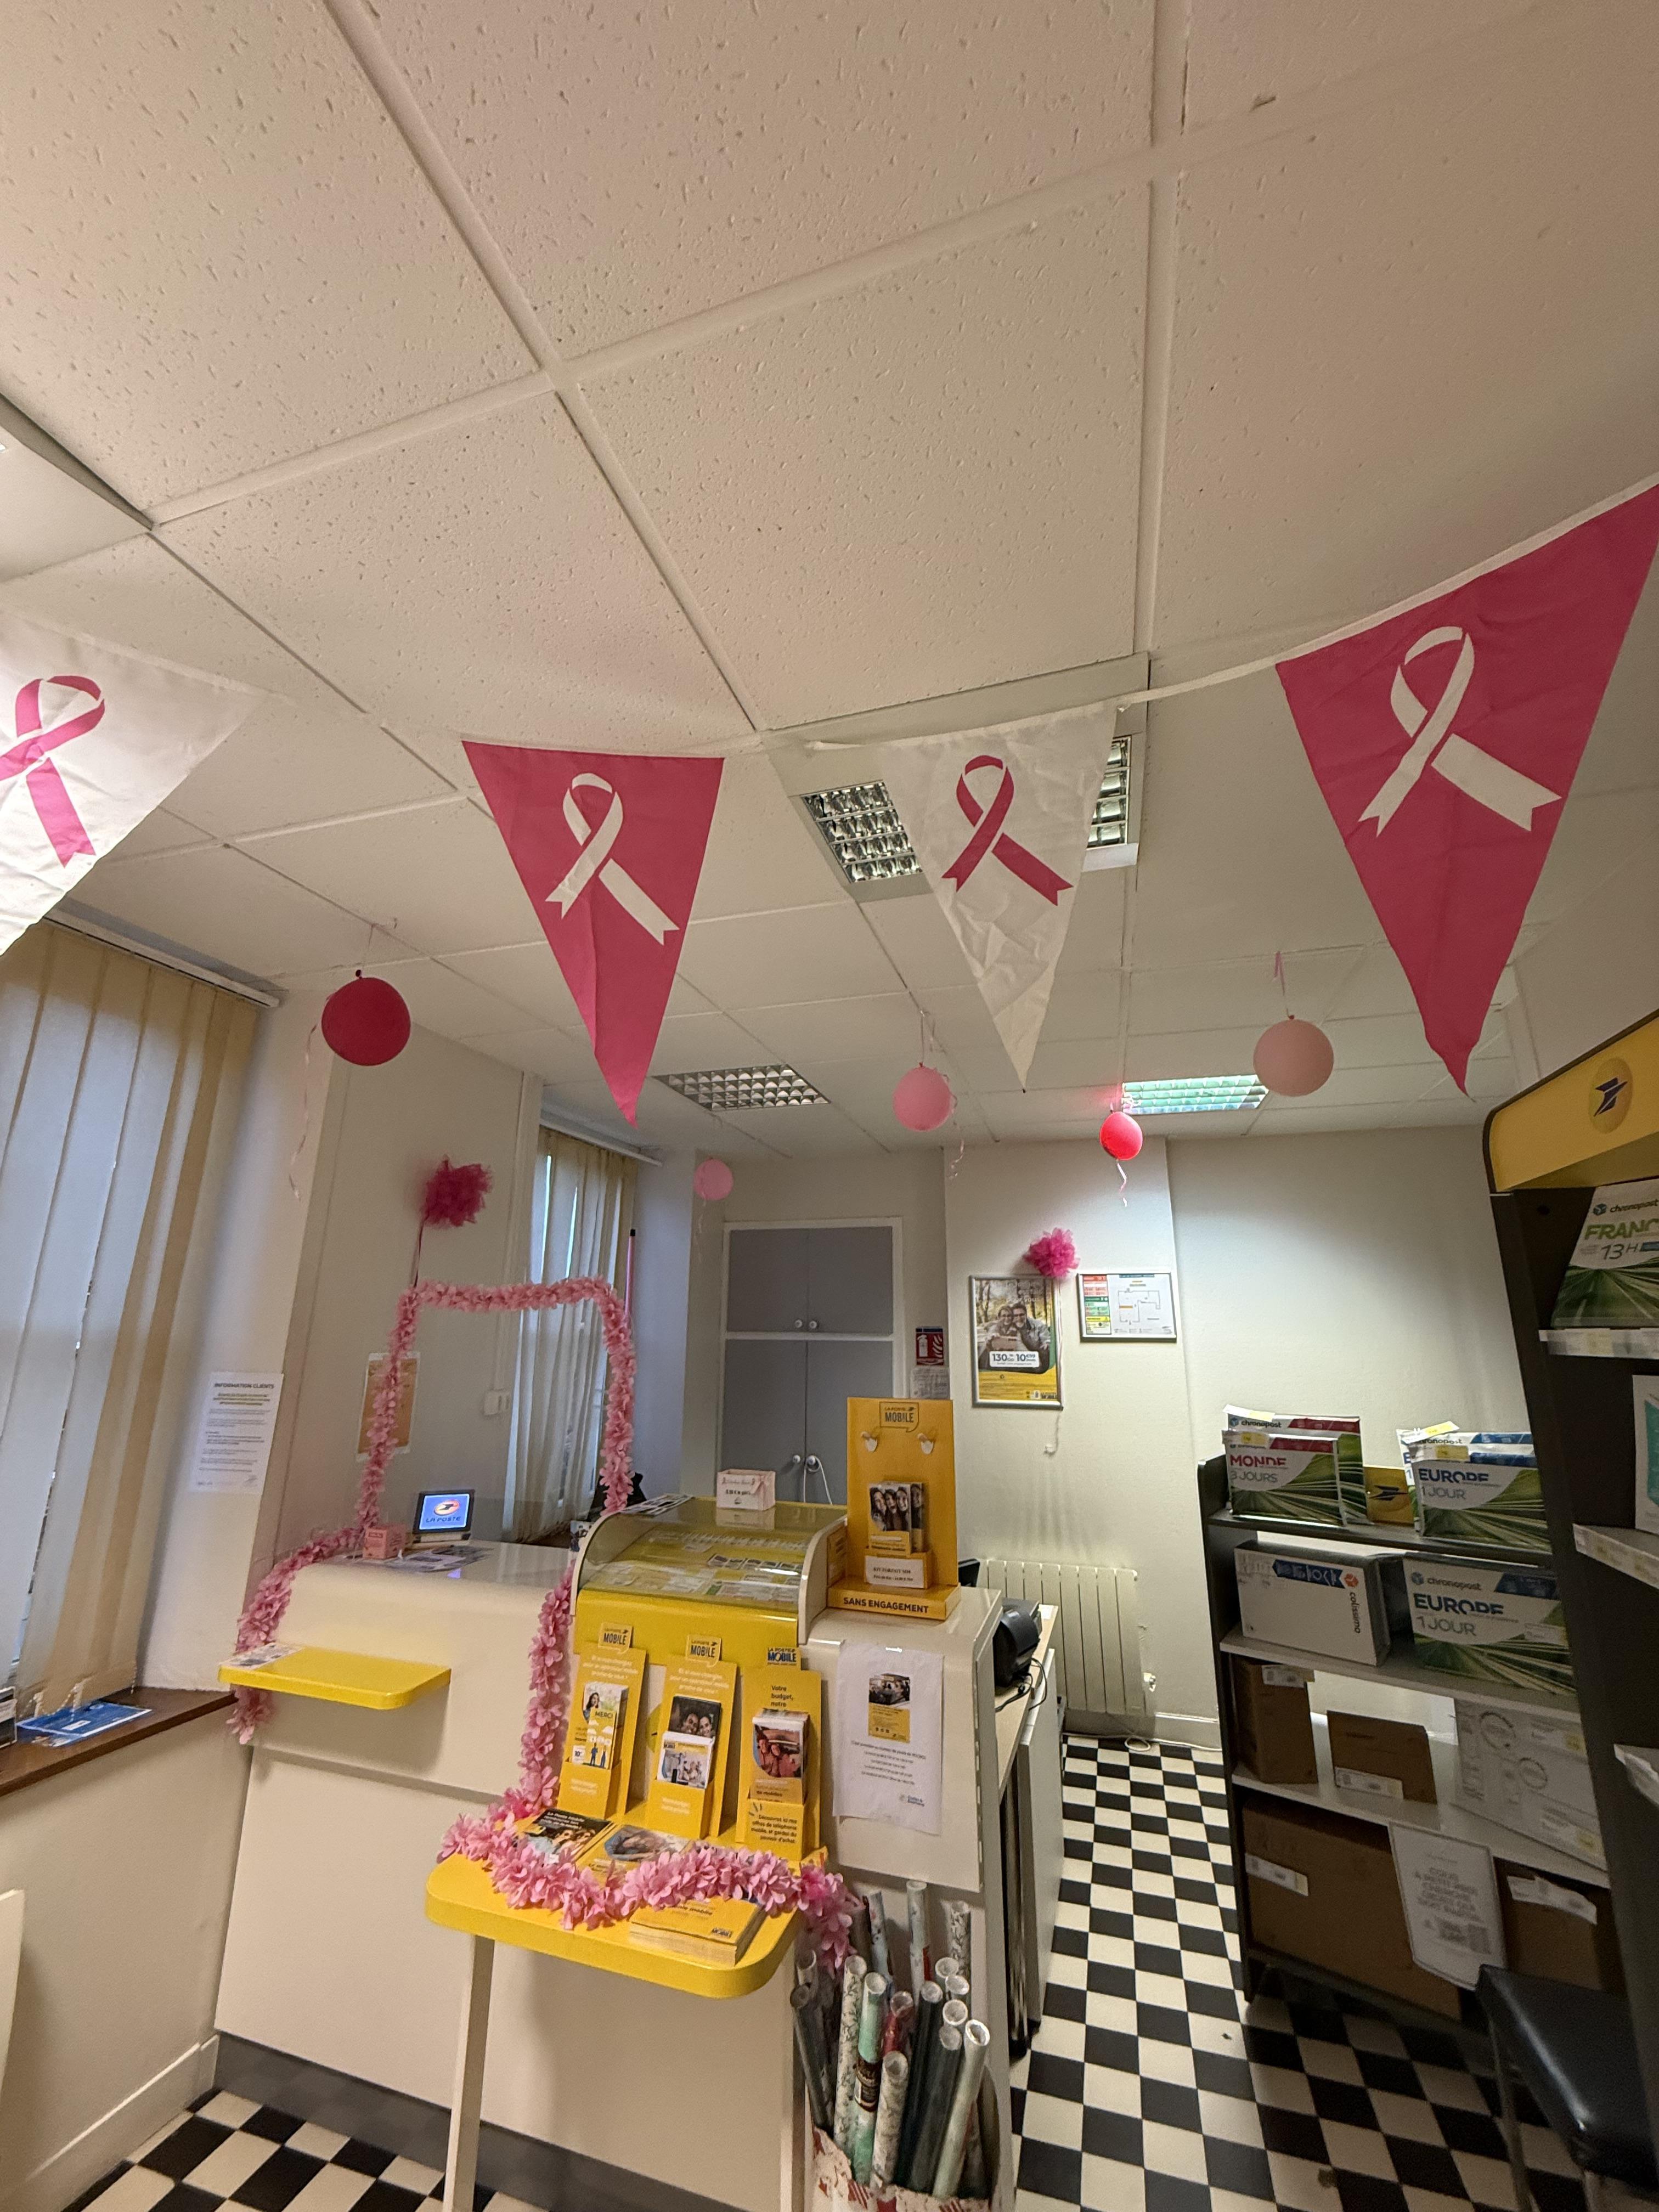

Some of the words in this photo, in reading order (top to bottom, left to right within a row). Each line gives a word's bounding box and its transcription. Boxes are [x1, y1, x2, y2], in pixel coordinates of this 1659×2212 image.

[1610, 1198, 1659, 1212] chronopost
[885, 1412, 914, 1423] MOBILE
[1241, 1419, 1282, 1429] chronopost
[1230, 1454, 1287, 1468] MONDE
[1229, 1470, 1238, 1480] 3
[1239, 1471, 1279, 1482] JOURS
[1418, 1468, 1489, 1483] EUROPE
[1421, 1486, 1426, 1497] 1
[1427, 1486, 1466, 1500] JOUR
[1427, 1577, 1482, 1591] chronopost
[844, 1597, 867, 1607] SANS
[868, 1600, 929, 1613] ENGAGEMENT
[1413, 1593, 1504, 1615] EUROPE
[1350, 1591, 1361, 1634] colissimo
[1416, 1616, 1425, 1629] 1
[1428, 1618, 1477, 1637] JOUR
[603, 1632, 627, 1645] MOBILE
[691, 1645, 715, 1658] MOBILE
[768, 1652, 797, 1662] MOBILE
[771, 1693, 793, 1701] budget,
